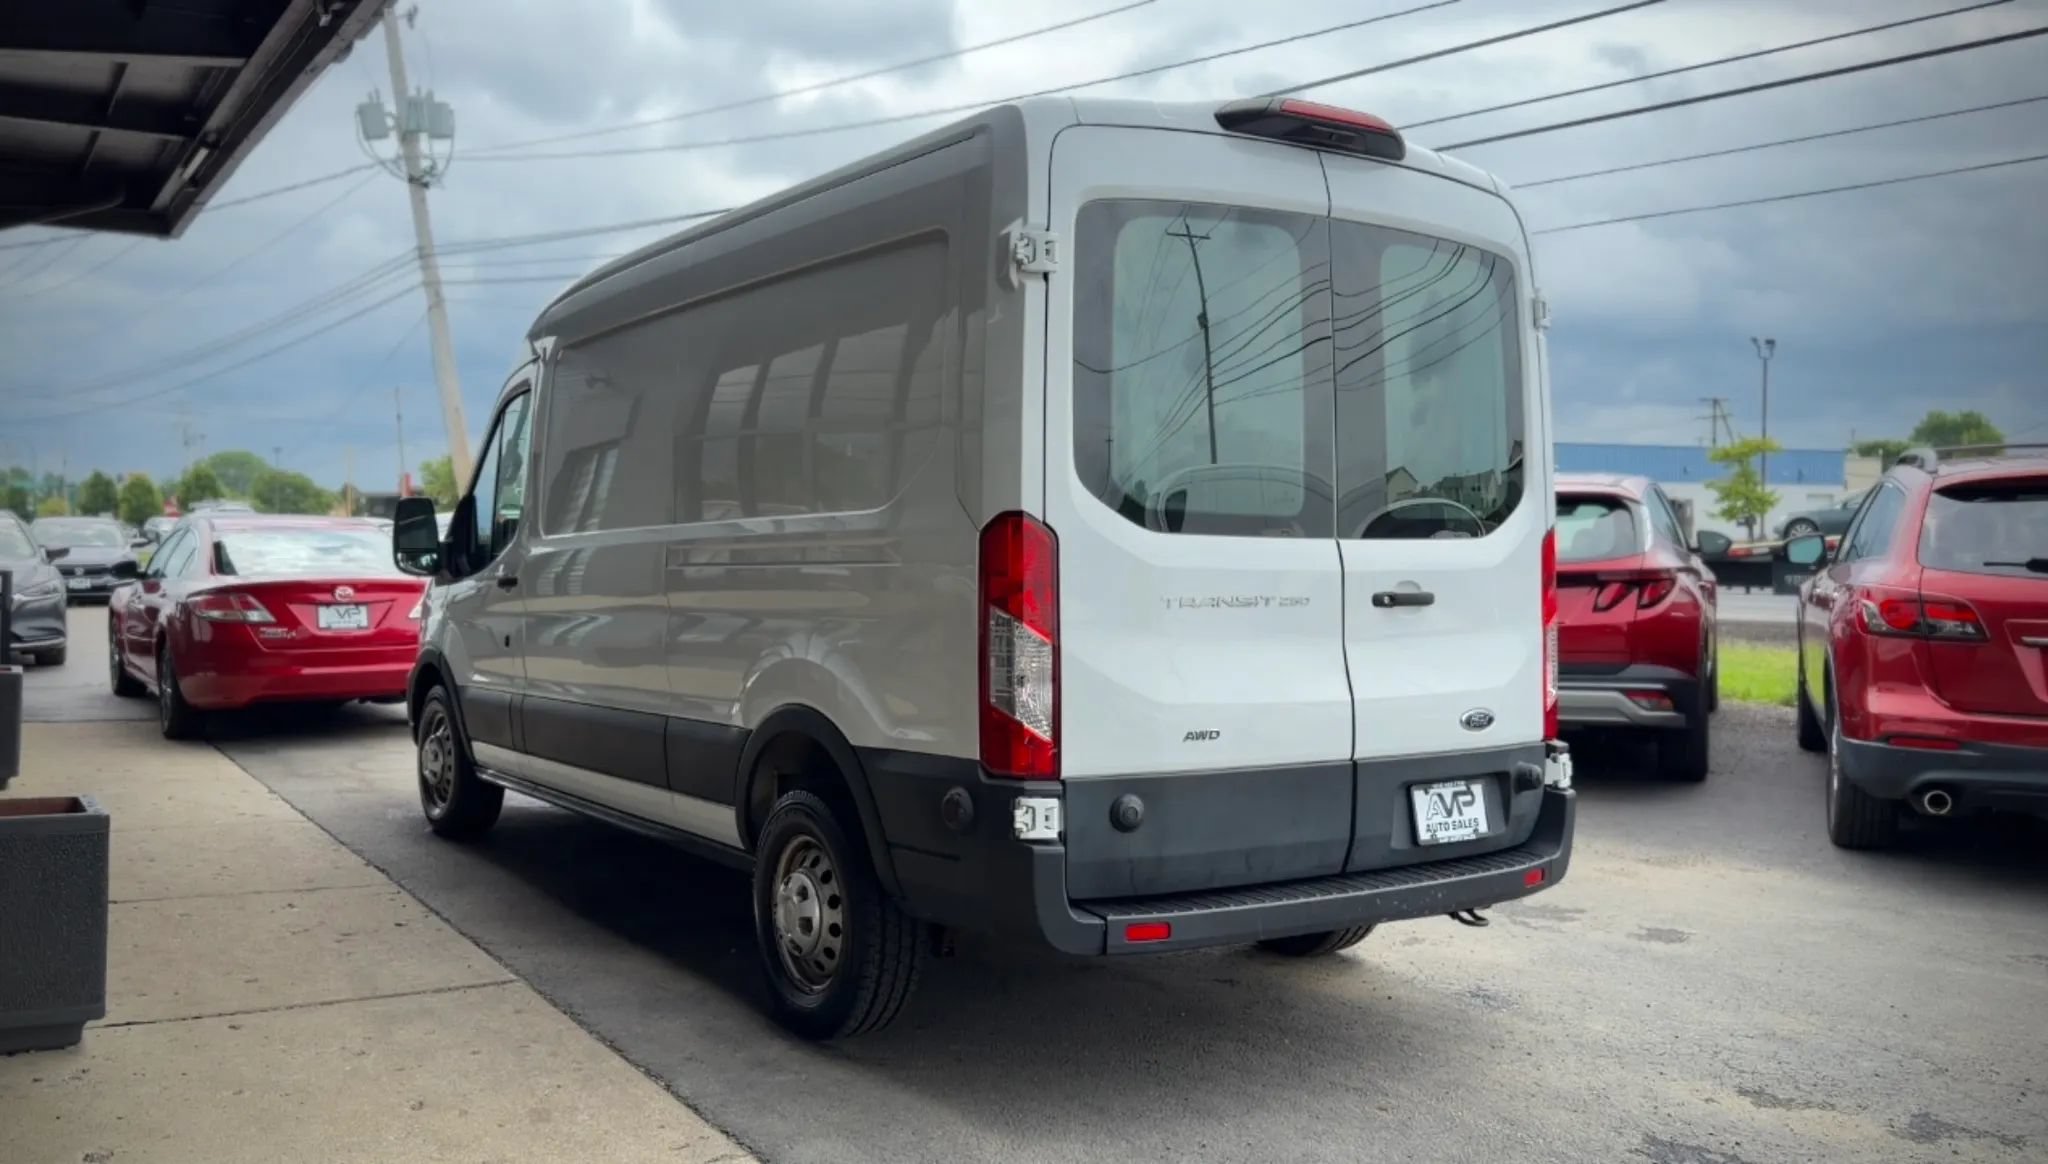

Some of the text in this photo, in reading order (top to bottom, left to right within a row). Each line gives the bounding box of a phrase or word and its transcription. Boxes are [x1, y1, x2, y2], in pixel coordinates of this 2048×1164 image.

[1182, 730, 1220, 742] AWD
[1426, 818, 1479, 833] AUTO SALES
